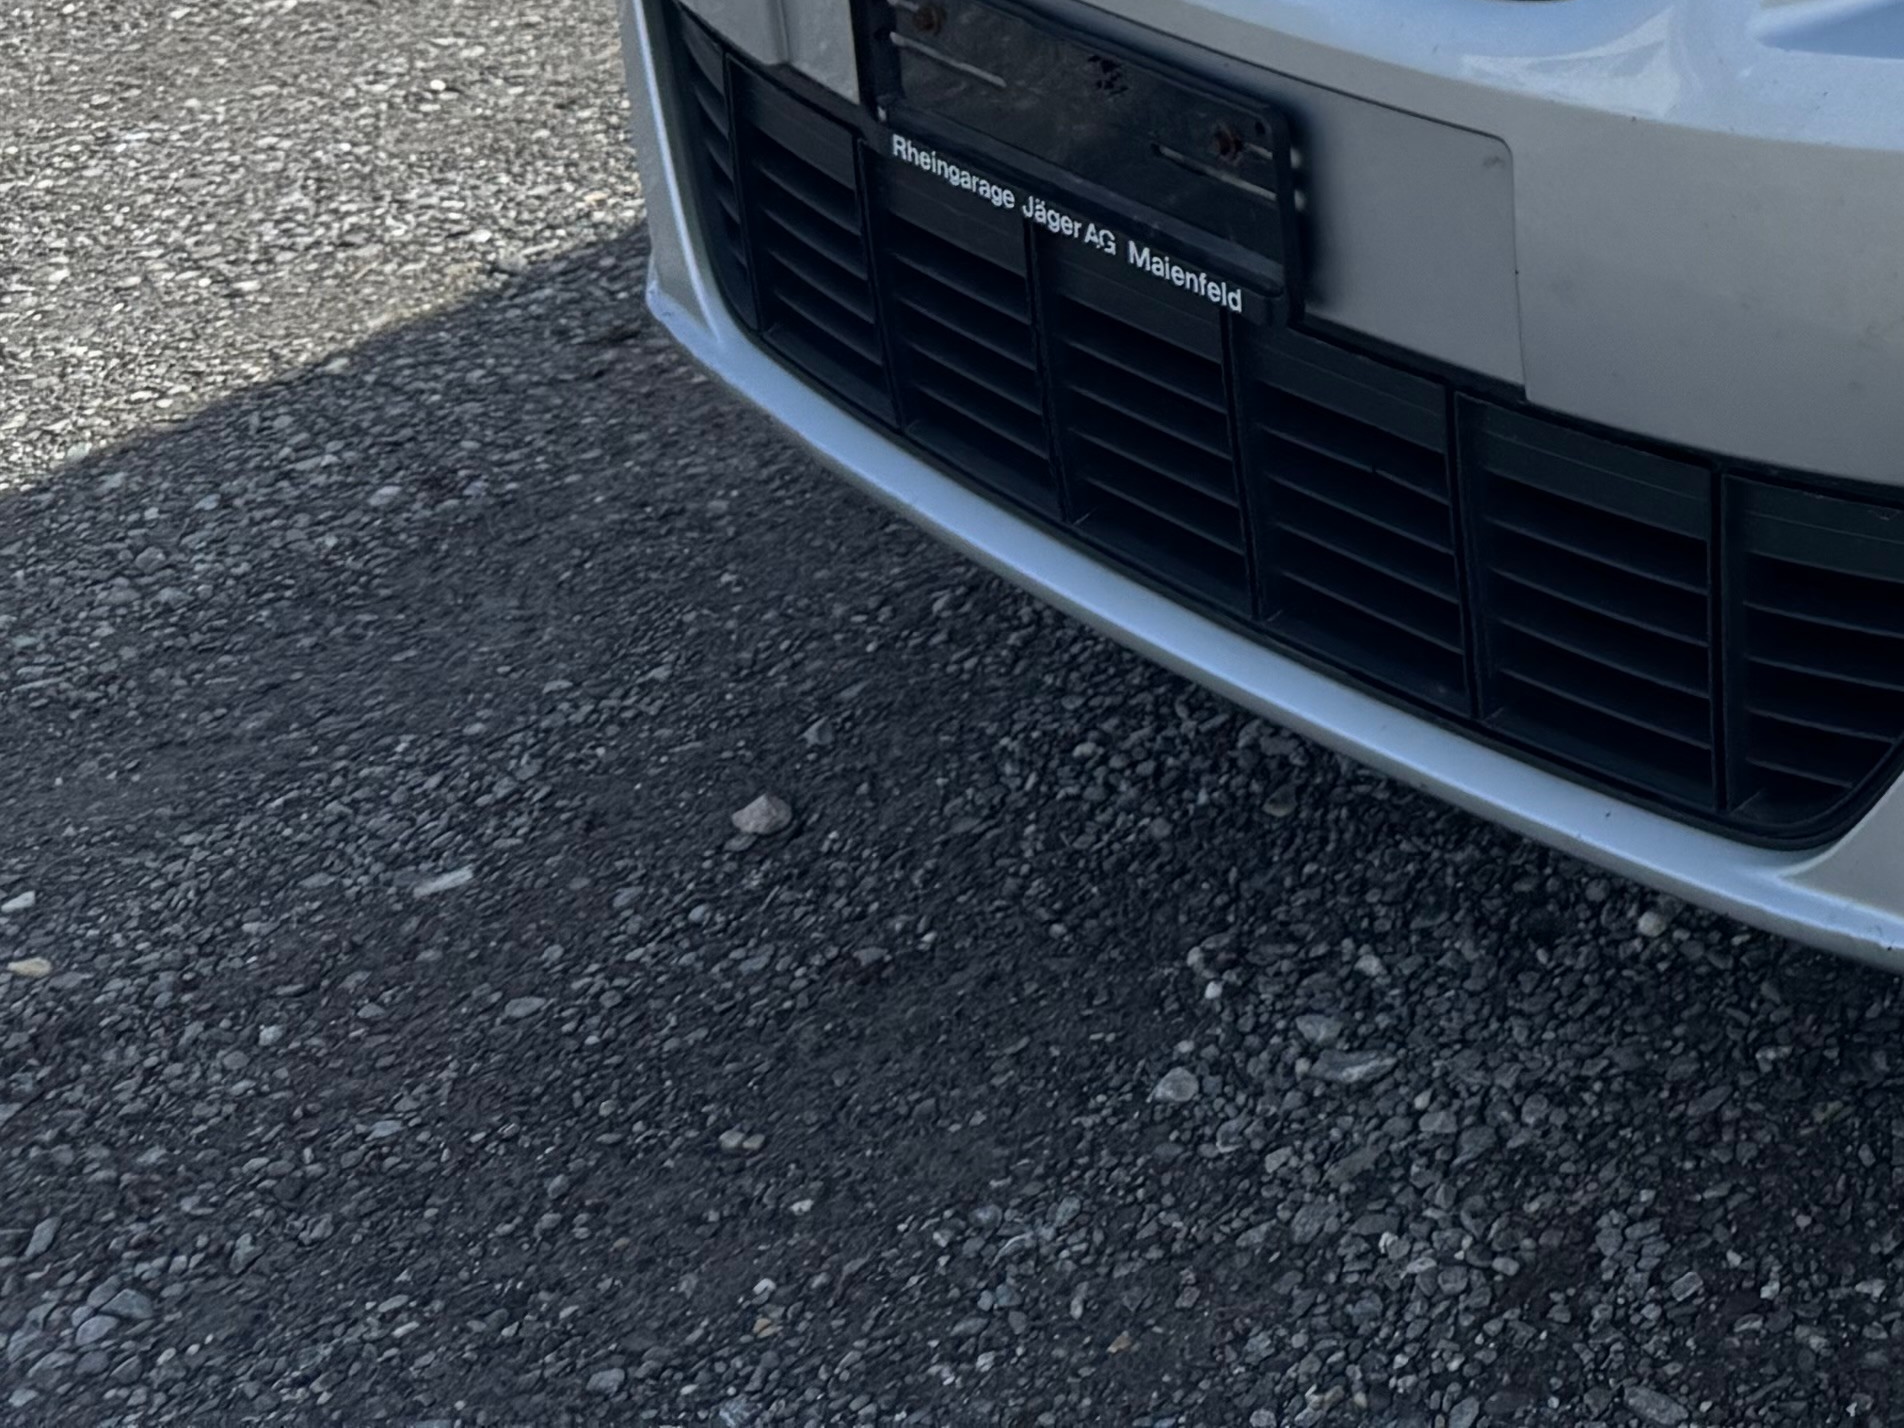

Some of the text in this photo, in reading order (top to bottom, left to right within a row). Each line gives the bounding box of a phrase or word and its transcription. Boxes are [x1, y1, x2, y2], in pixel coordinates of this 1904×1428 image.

[891, 133, 1242, 313] Rheingarage Jäger AG Maienfeld
